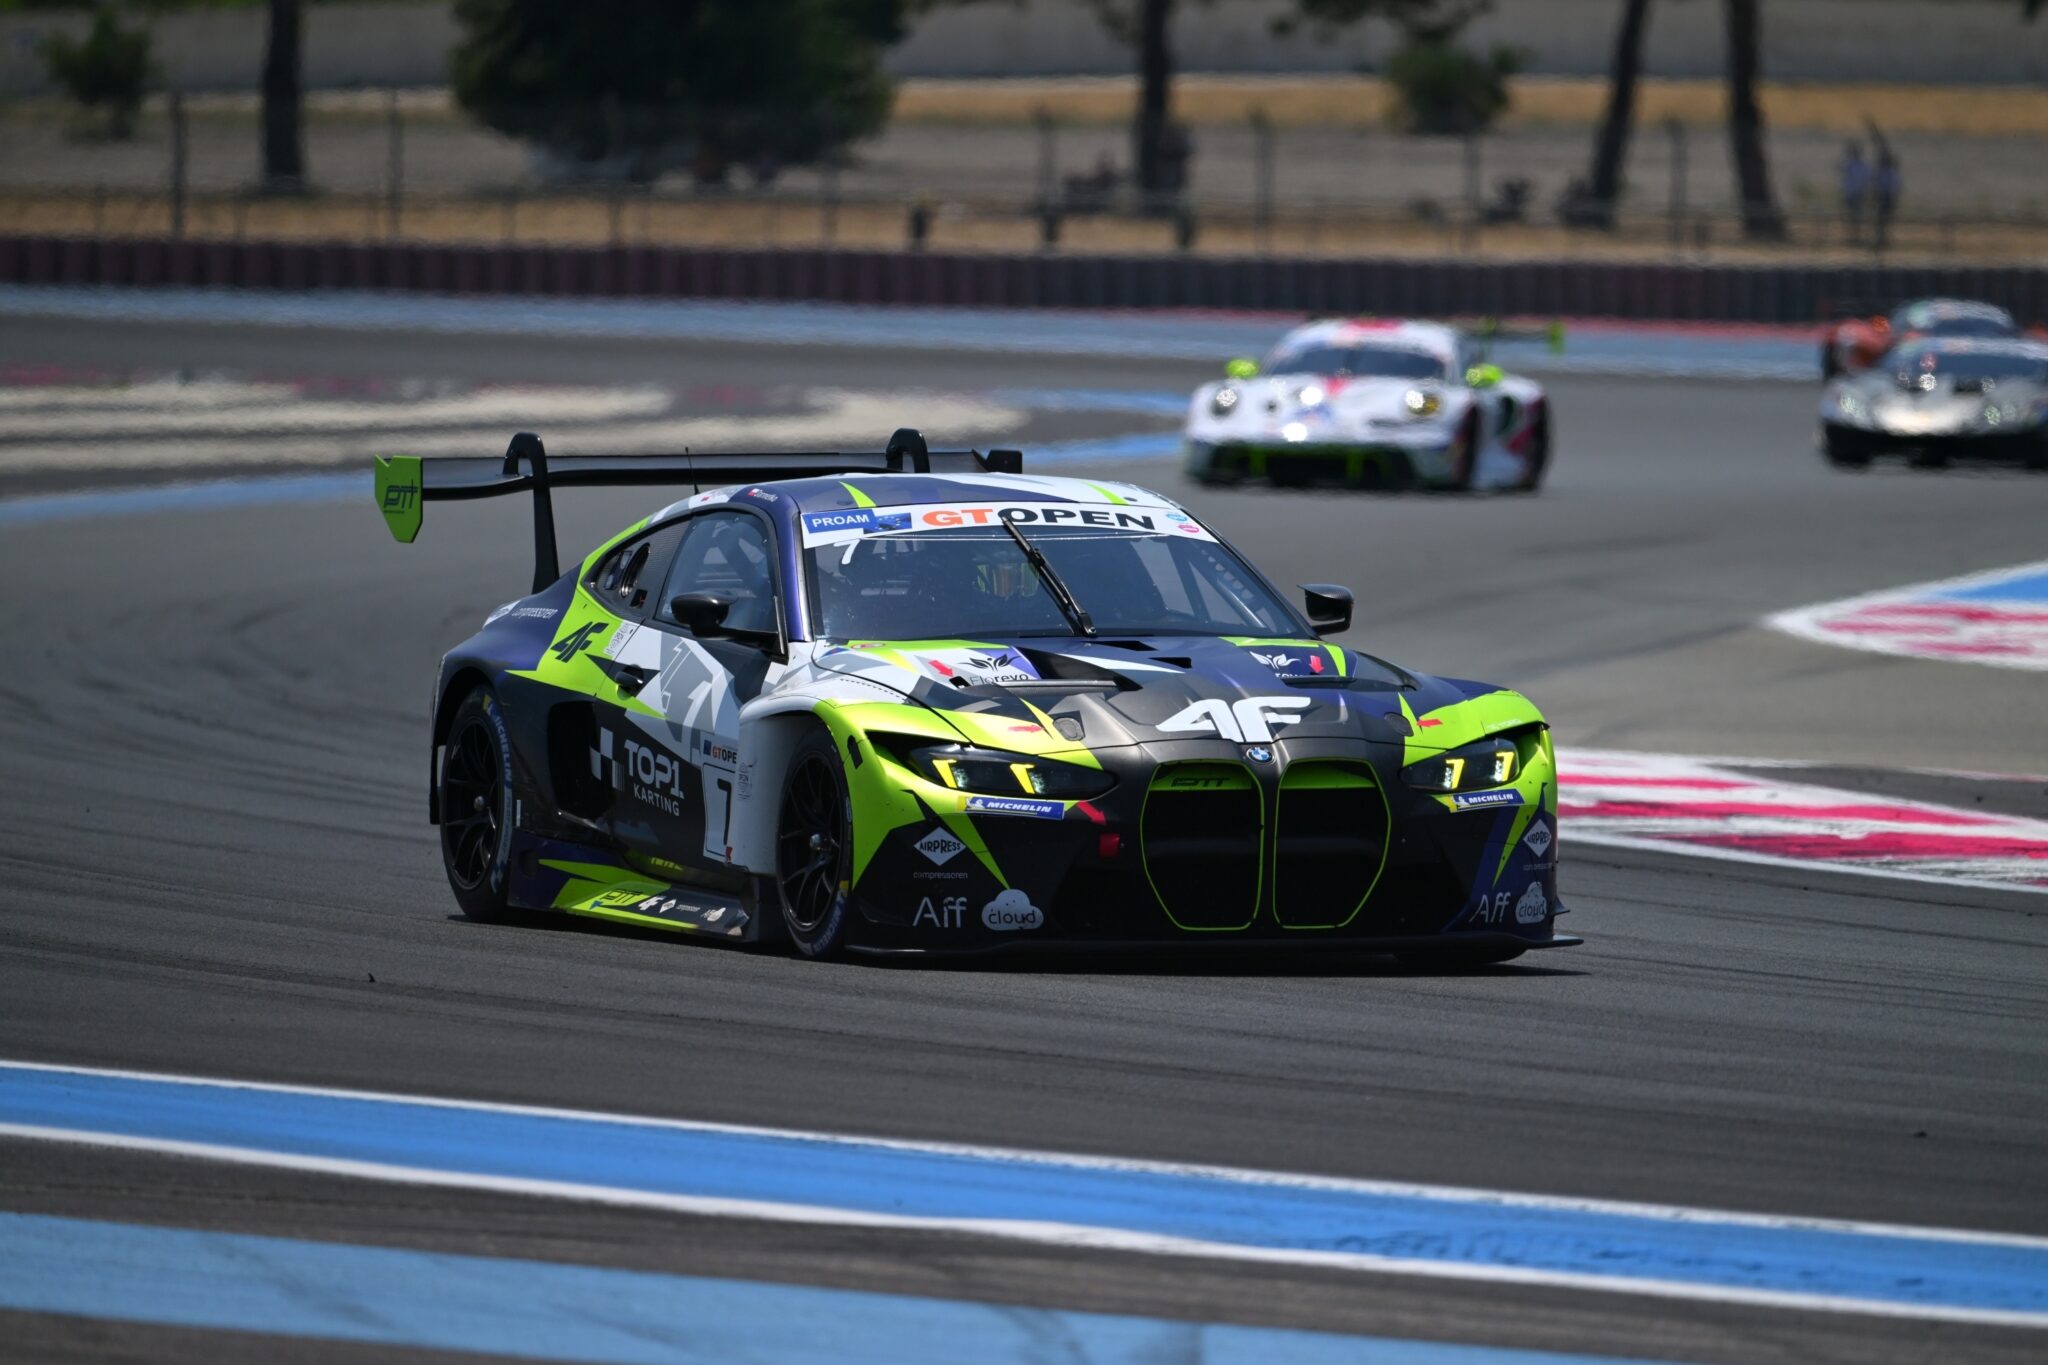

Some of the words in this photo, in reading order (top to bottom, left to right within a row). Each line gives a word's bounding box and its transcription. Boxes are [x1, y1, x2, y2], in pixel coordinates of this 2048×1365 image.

[812, 514, 870, 528] PROAM
[833, 538, 861, 565] 7
[712, 745, 737, 764] GTOPE
[624, 739, 685, 799] TOP1
[633, 784, 680, 817] KARTING
[986, 802, 1052, 813] MICHELIN
[1468, 793, 1514, 804] MICHELIN
[717, 778, 732, 845] 7
[920, 839, 961, 853] AIRPRESS
[988, 909, 1036, 924] cloud
[1518, 900, 1546, 918] cloud
